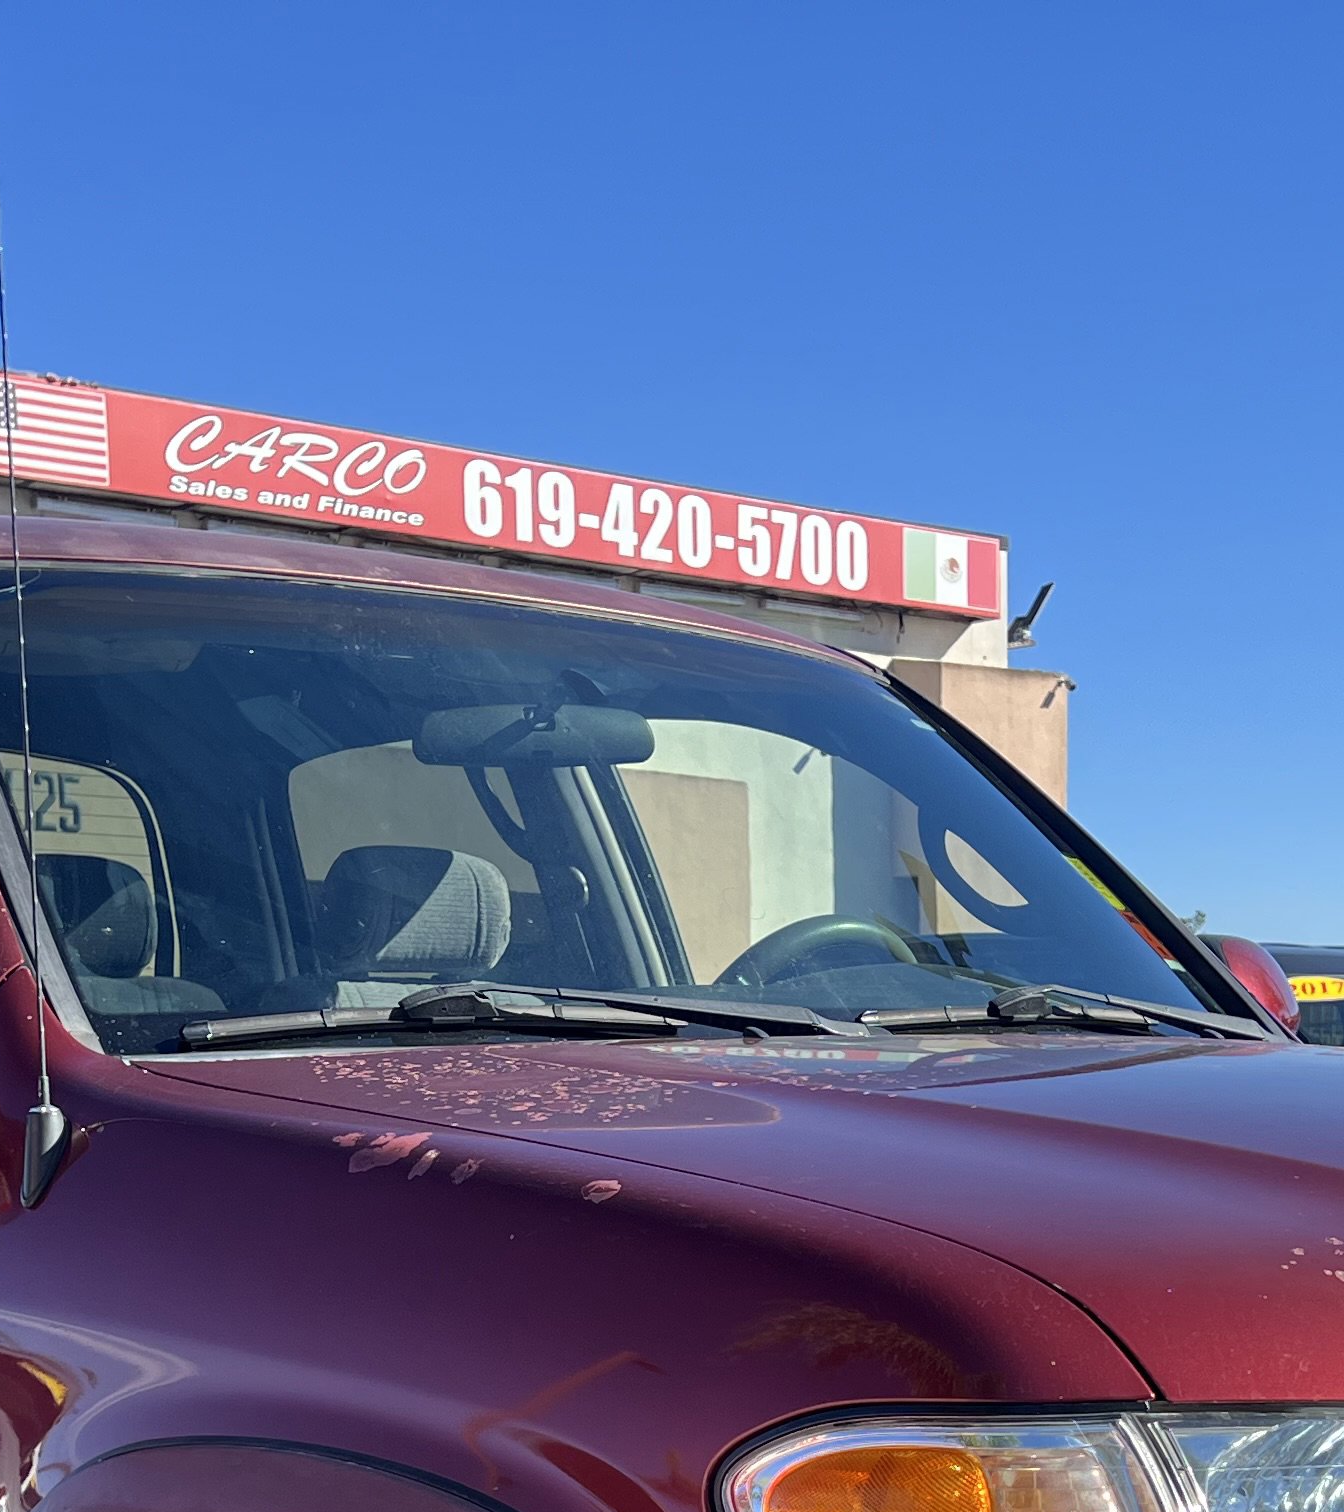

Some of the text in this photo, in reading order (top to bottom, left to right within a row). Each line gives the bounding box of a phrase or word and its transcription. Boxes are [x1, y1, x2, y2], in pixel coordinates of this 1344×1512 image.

[164, 415, 427, 496] CARCO
[168, 475, 426, 526] Sales and Finance
[463, 459, 869, 592] 619-420-5700
